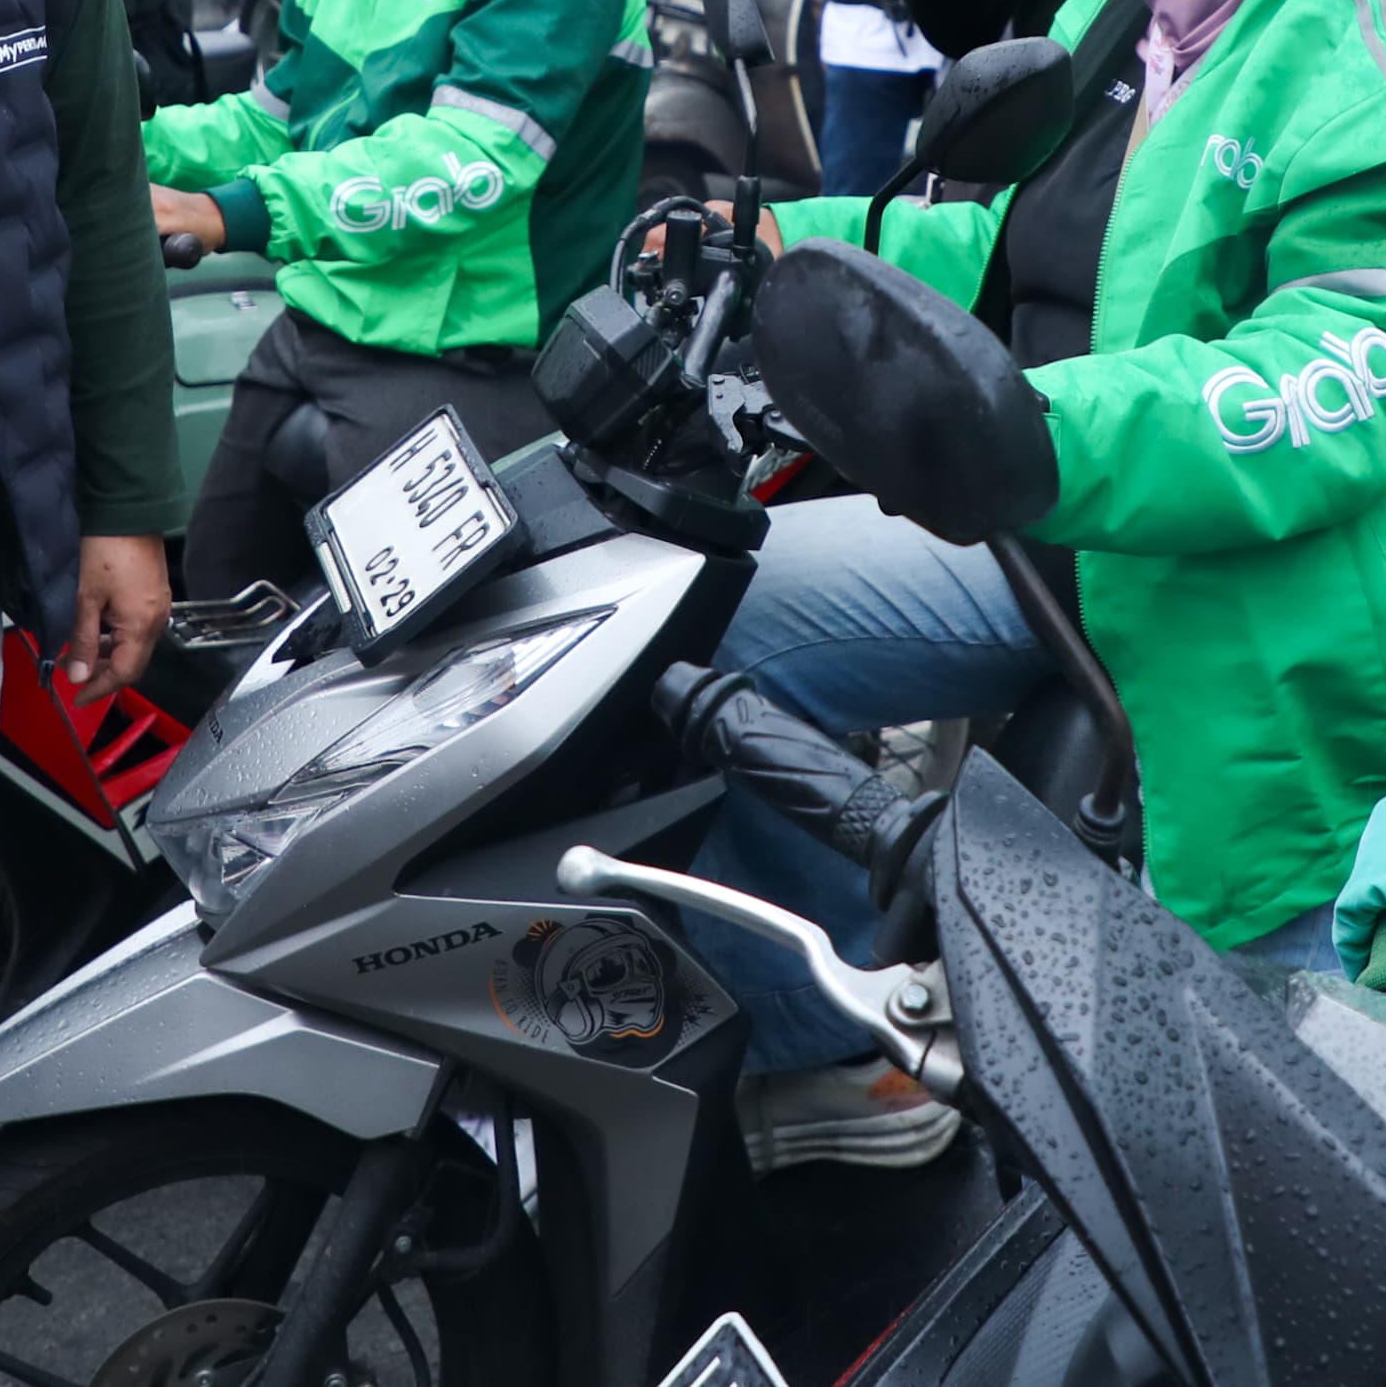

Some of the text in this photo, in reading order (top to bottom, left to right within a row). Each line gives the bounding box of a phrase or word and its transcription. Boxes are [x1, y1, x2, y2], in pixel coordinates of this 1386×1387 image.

[329, 151, 505, 234] Grab
[388, 427, 439, 474] H
[431, 508, 491, 572] FR
[351, 920, 504, 976] HONDA
